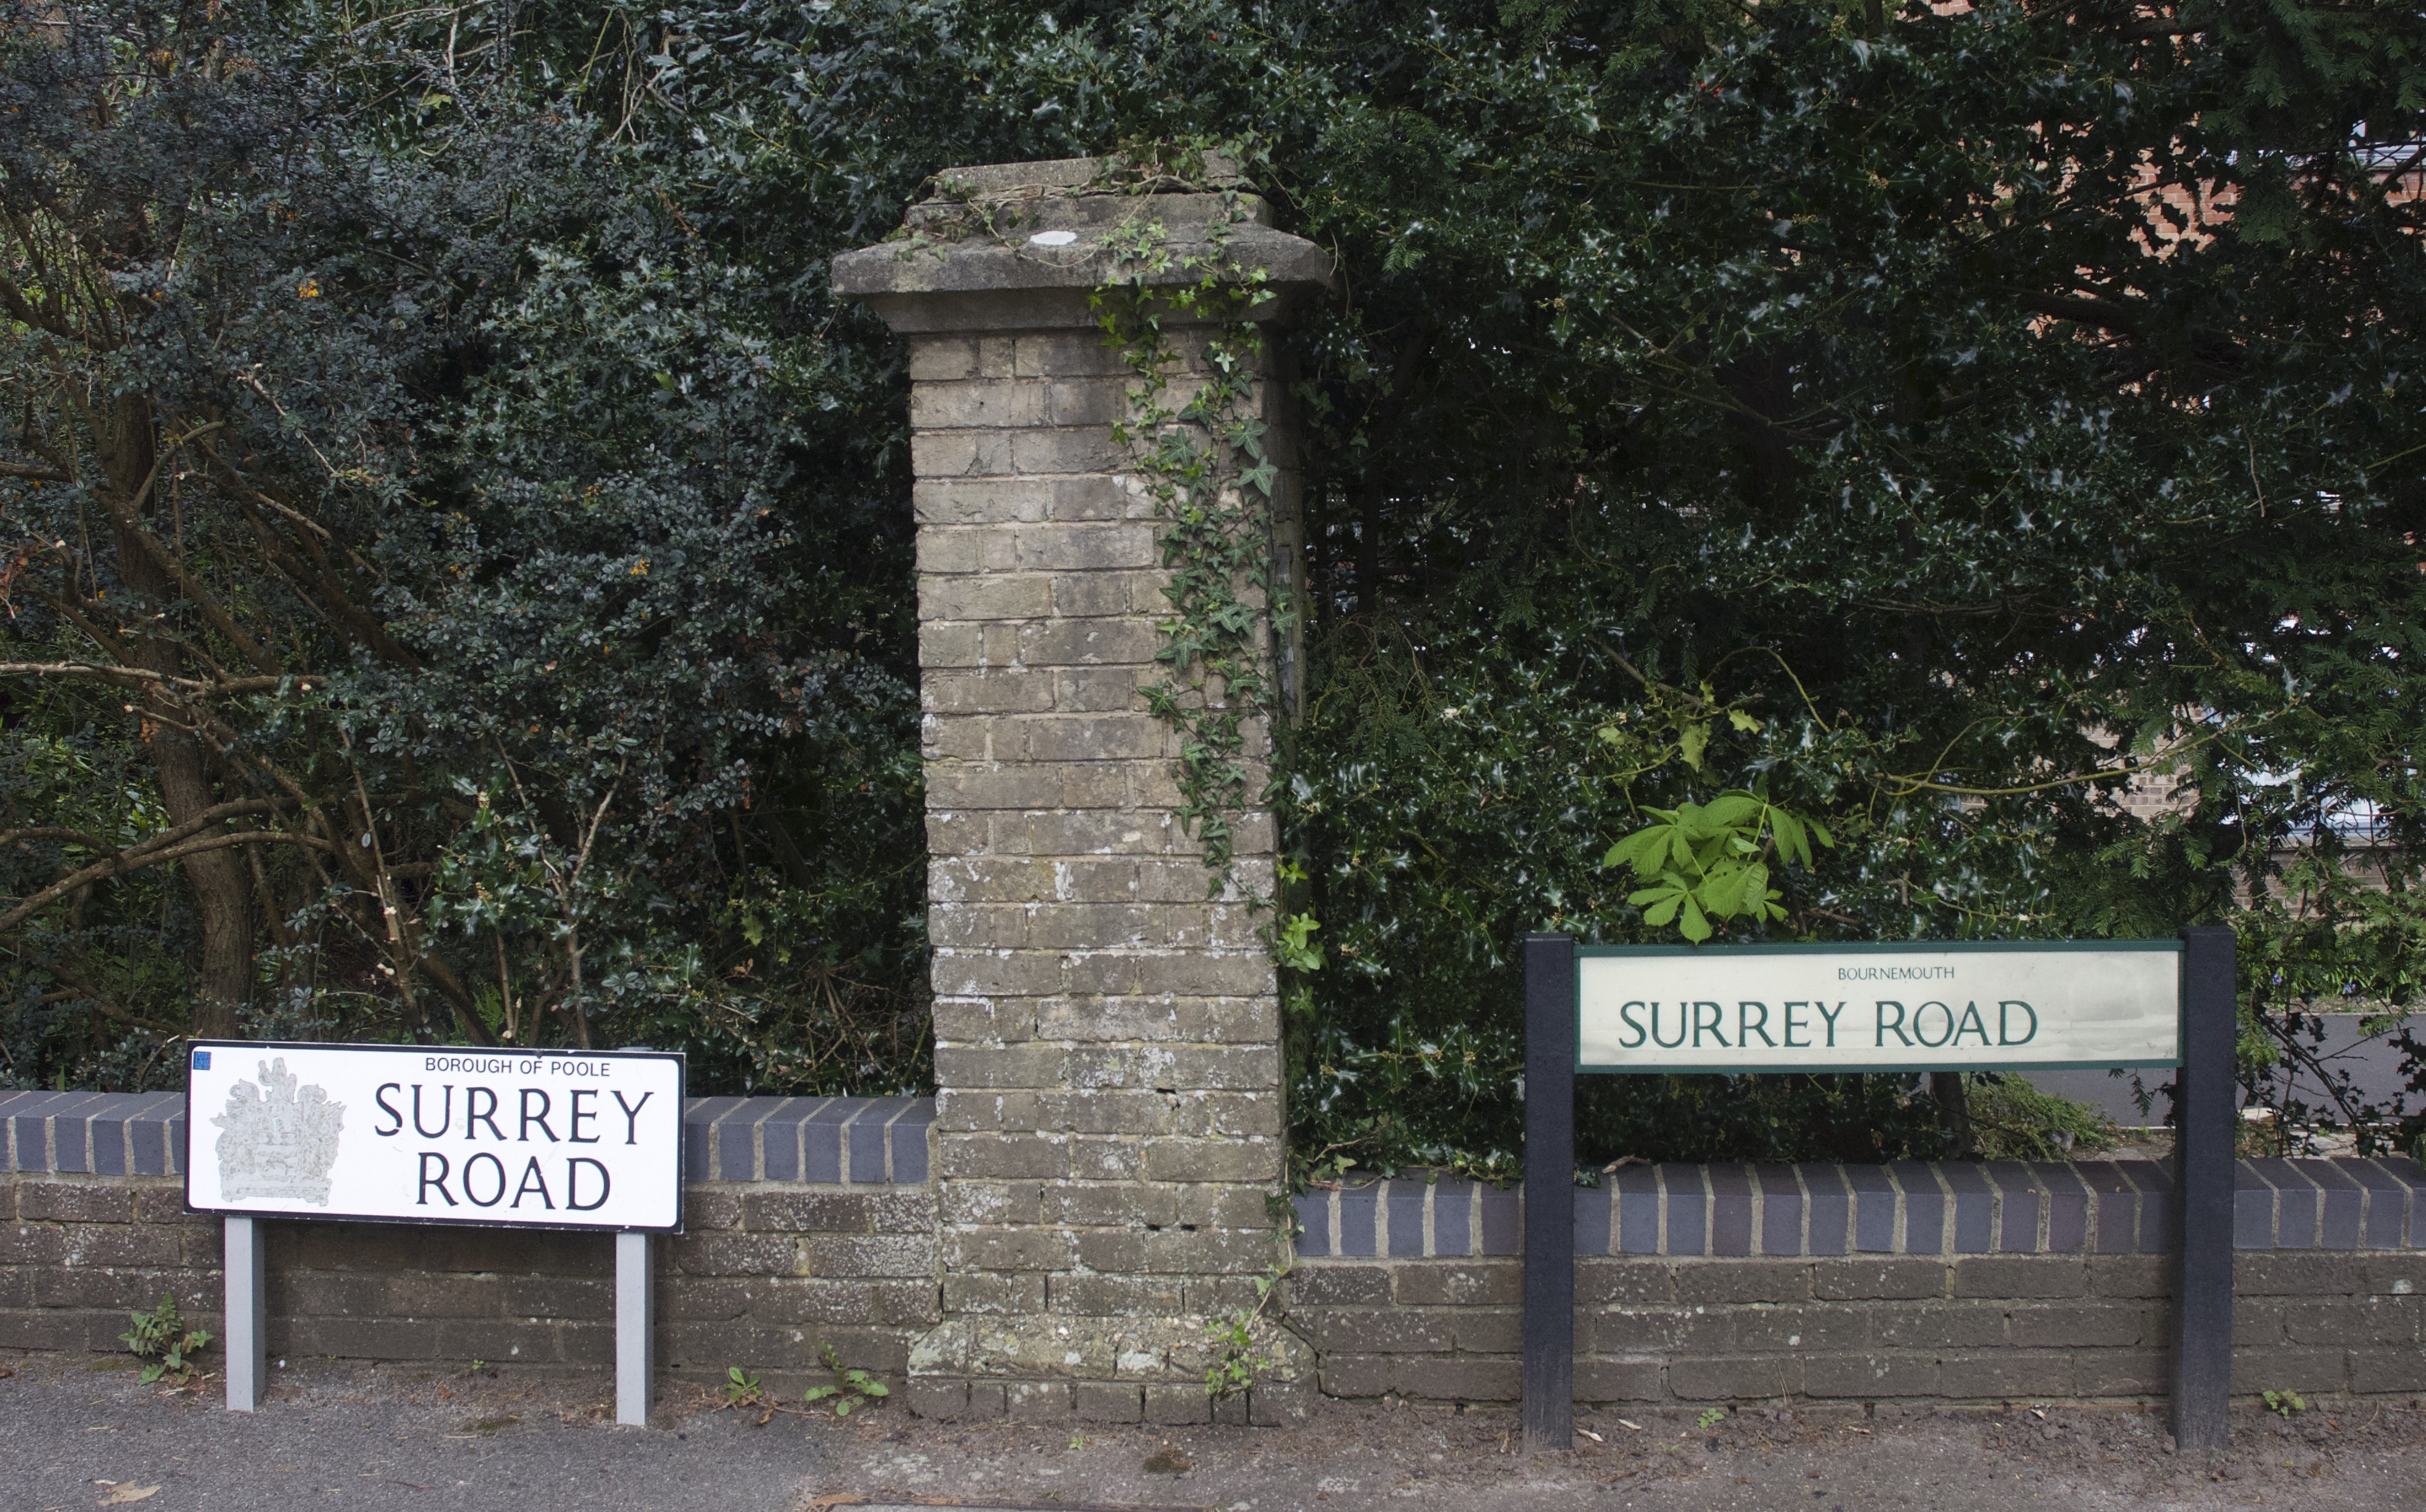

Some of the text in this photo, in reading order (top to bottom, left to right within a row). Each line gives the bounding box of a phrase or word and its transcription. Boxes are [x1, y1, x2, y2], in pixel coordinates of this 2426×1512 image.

[1838, 966, 1954, 980] BOURNEMOUTH
[1618, 1000, 2038, 1049] SURREY ROAD
[425, 1057, 610, 1077] BOROUGH OF POOLE
[374, 1082, 655, 1146] SURREY
[415, 1151, 611, 1211] ROAD
